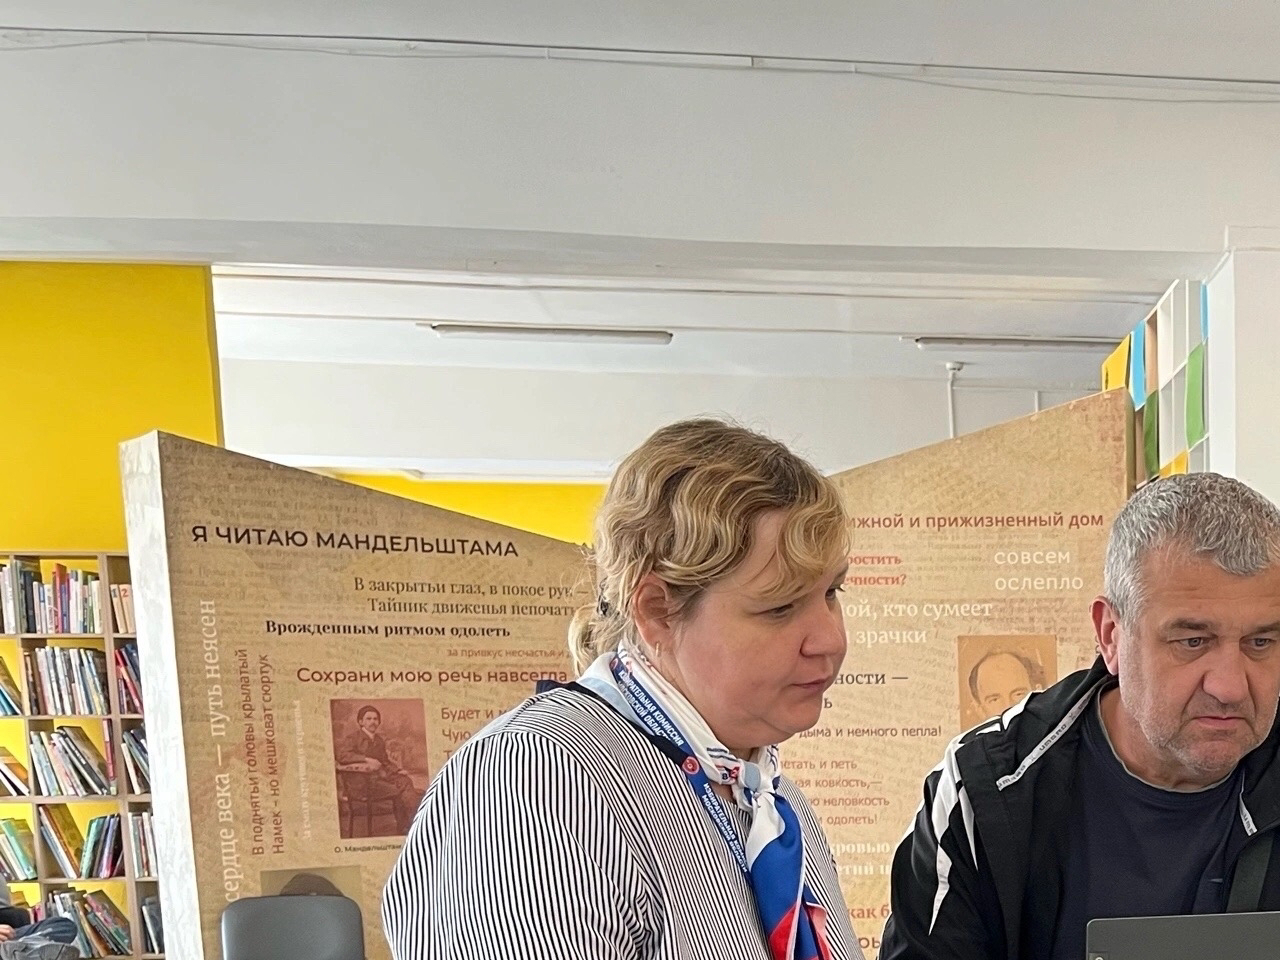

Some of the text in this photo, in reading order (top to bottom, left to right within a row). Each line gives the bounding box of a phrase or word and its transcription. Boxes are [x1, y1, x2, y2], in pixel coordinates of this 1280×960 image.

[909, 517, 920, 528] и
[926, 512, 1064, 532] прижизненный
[1068, 513, 1104, 529] дом
[192, 525, 519, 557] Я ЧИТАЮ МАНДЕЛЬШТАМА
[994, 551, 1071, 565] совсем
[354, 577, 365, 591] В
[369, 580, 446, 594] закрытьи
[450, 583, 485, 596] глаз,
[490, 585, 498, 595] в
[502, 585, 545, 596] покое
[995, 575, 1084, 591] ослепло
[367, 598, 428, 613] Тайник
[431, 603, 507, 616] движенья
[883, 604, 918, 617] кто
[923, 603, 994, 620] сумеет
[266, 620, 511, 638] Врожденным ритмом одолеть
[200, 600, 221, 679] неясен
[856, 630, 927, 648] зрачки
[259, 655, 274, 703] сюртук
[297, 667, 384, 686] Сохрани
[391, 671, 432, 683] мою
[438, 671, 482, 686] речь
[208, 685, 231, 737] путь
[441, 707, 481, 722] Будет
[486, 709, 494, 718] и
[652, 705, 685, 747] КОМИССИЯ
[836, 728, 843, 737] и
[847, 727, 898, 737] немного
[902, 725, 942, 737] пепла!
[263, 706, 278, 775] мешковат
[234, 649, 266, 856] В поднятьи головы крылатый
[820, 760, 827, 769] и
[830, 760, 857, 769] петь
[270, 780, 280, 797] но
[215, 773, 233, 824] века
[823, 797, 890, 807] неловкость
[827, 814, 878, 826] одолеть!
[273, 810, 285, 854] Намек
